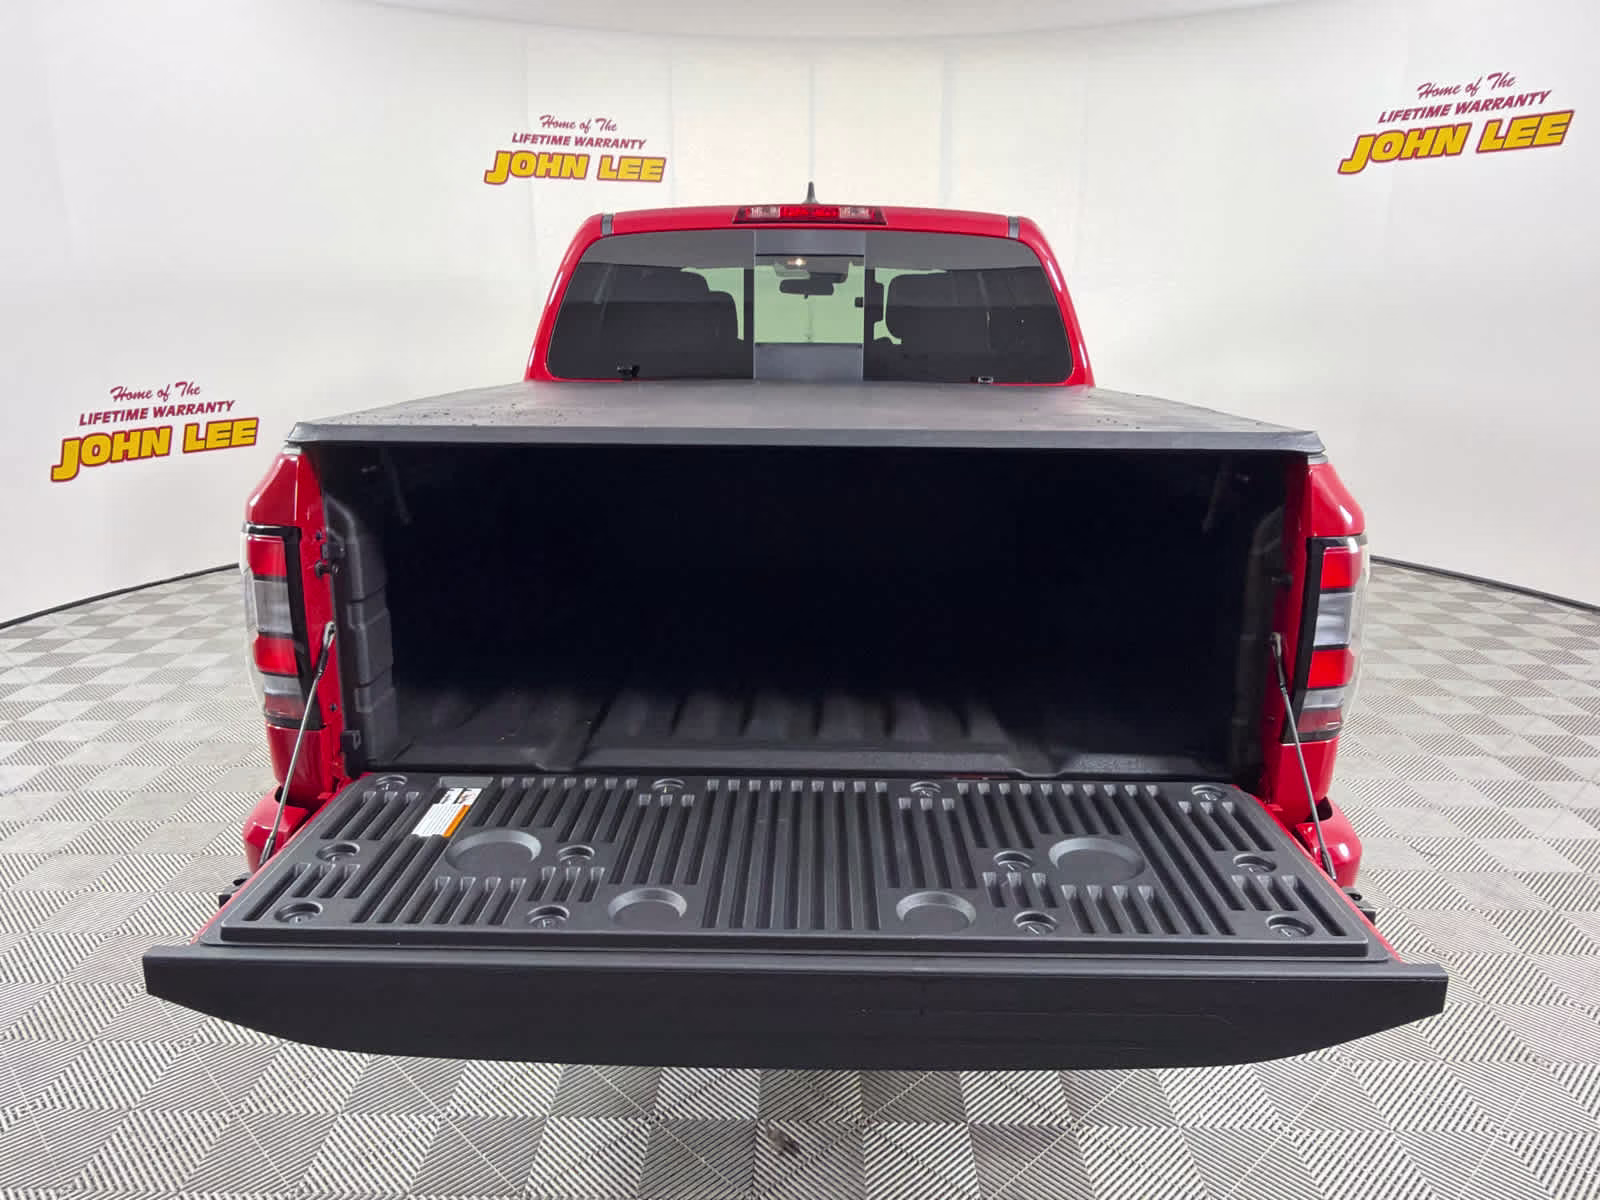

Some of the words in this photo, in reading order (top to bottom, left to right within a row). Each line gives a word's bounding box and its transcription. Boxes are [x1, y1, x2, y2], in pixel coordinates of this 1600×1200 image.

[1417, 82, 1461, 100] Home
[1465, 76, 1482, 96] of
[1487, 71, 1517, 90] The
[1378, 103, 1452, 124] LIFETIME
[1455, 90, 1552, 115] WARRANTY
[539, 114, 575, 130] Home
[579, 119, 592, 133] of
[595, 117, 617, 132] The
[511, 132, 571, 147] LIFETIME
[574, 136, 647, 150] WARRANTY
[1337, 122, 1472, 175] JOHN
[1475, 109, 1575, 153] LEE
[484, 151, 590, 185] JOHN
[597, 154, 667, 183] LEE
[110, 385, 153, 402] Home
[157, 384, 170, 402] of
[175, 381, 200, 397] The
[79, 407, 149, 426] LIFETIME
[152, 400, 235, 418] WARRANTY
[51, 425, 173, 482] JOHN
[182, 417, 259, 454] LEE
